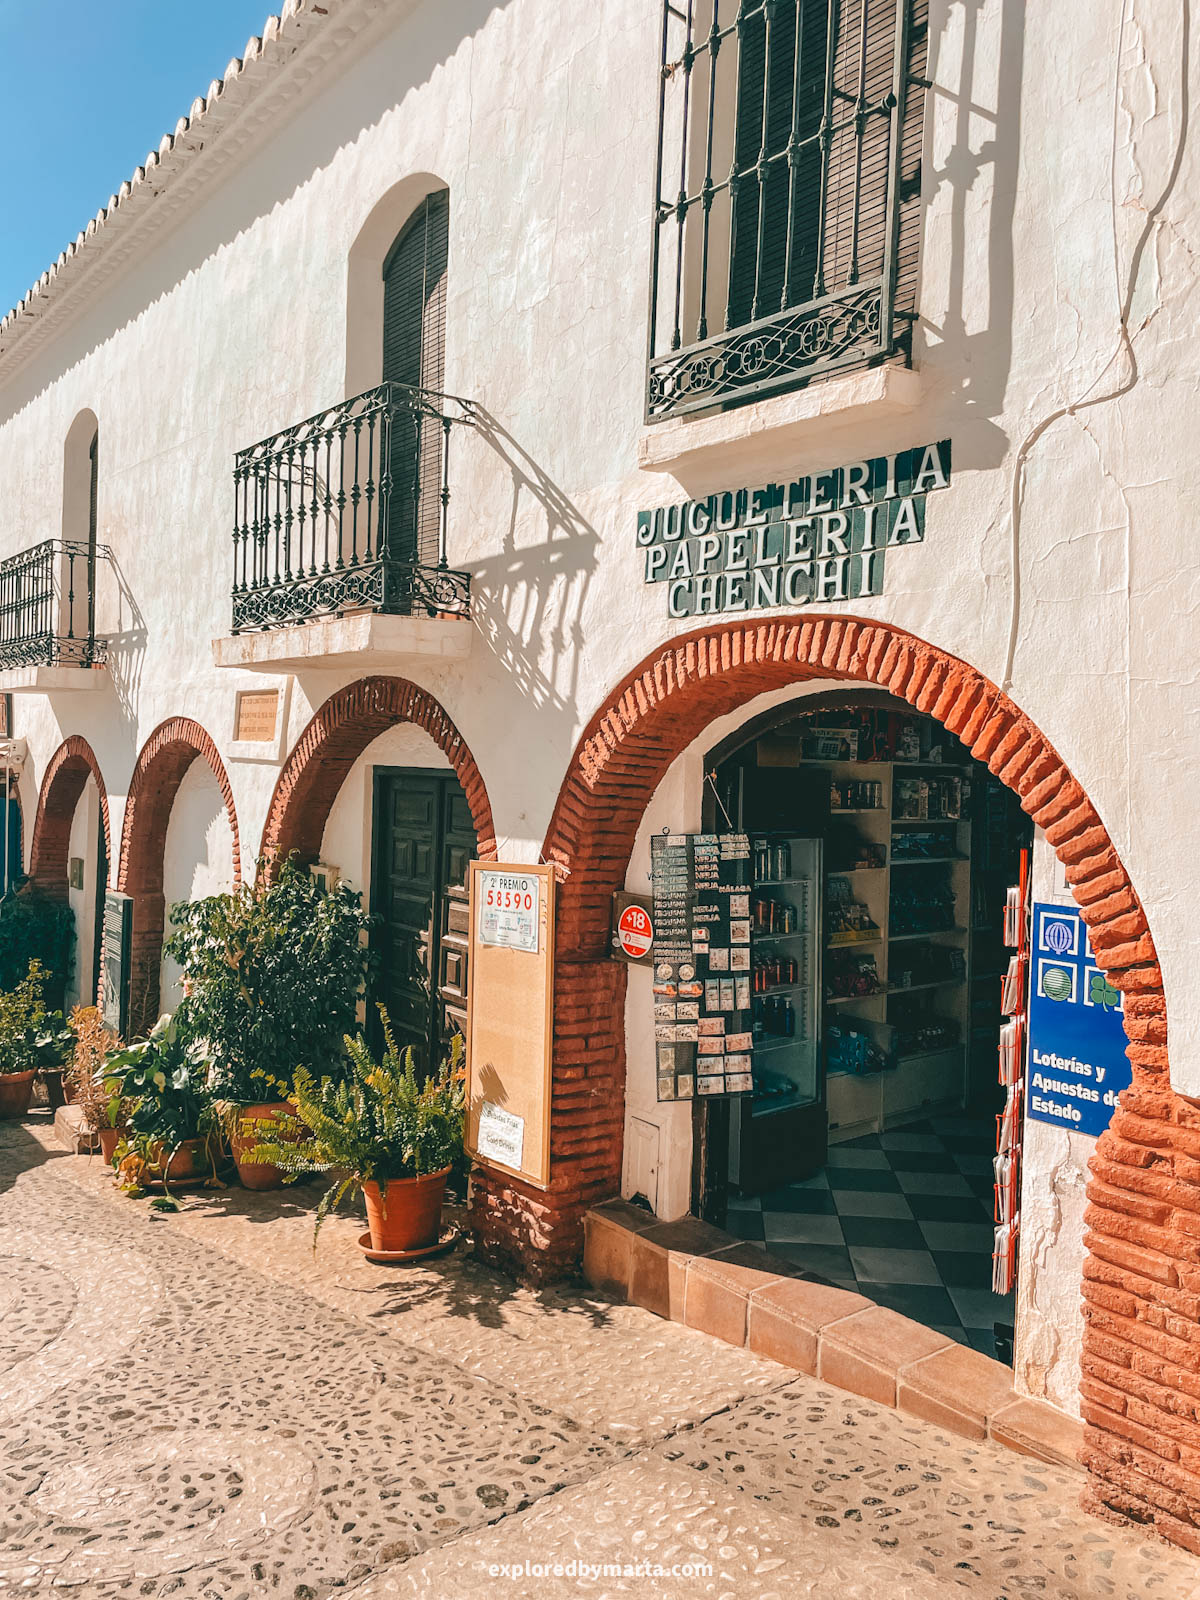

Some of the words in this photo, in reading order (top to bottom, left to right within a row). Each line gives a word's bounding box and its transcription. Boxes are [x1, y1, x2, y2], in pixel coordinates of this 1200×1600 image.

[637, 444, 949, 545] JUGUETERIA
[645, 498, 922, 583] PAPELERIA
[668, 551, 878, 618] CHENCHI
[499, 878, 528, 891] PREMIO
[487, 890, 532, 910] 58590
[626, 911, 645, 929] +18
[1032, 1049, 1092, 1076] Loterías
[1095, 1066, 1106, 1083] y
[1032, 1072, 1099, 1102] Apuestas
[1032, 1095, 1082, 1122] Estado
